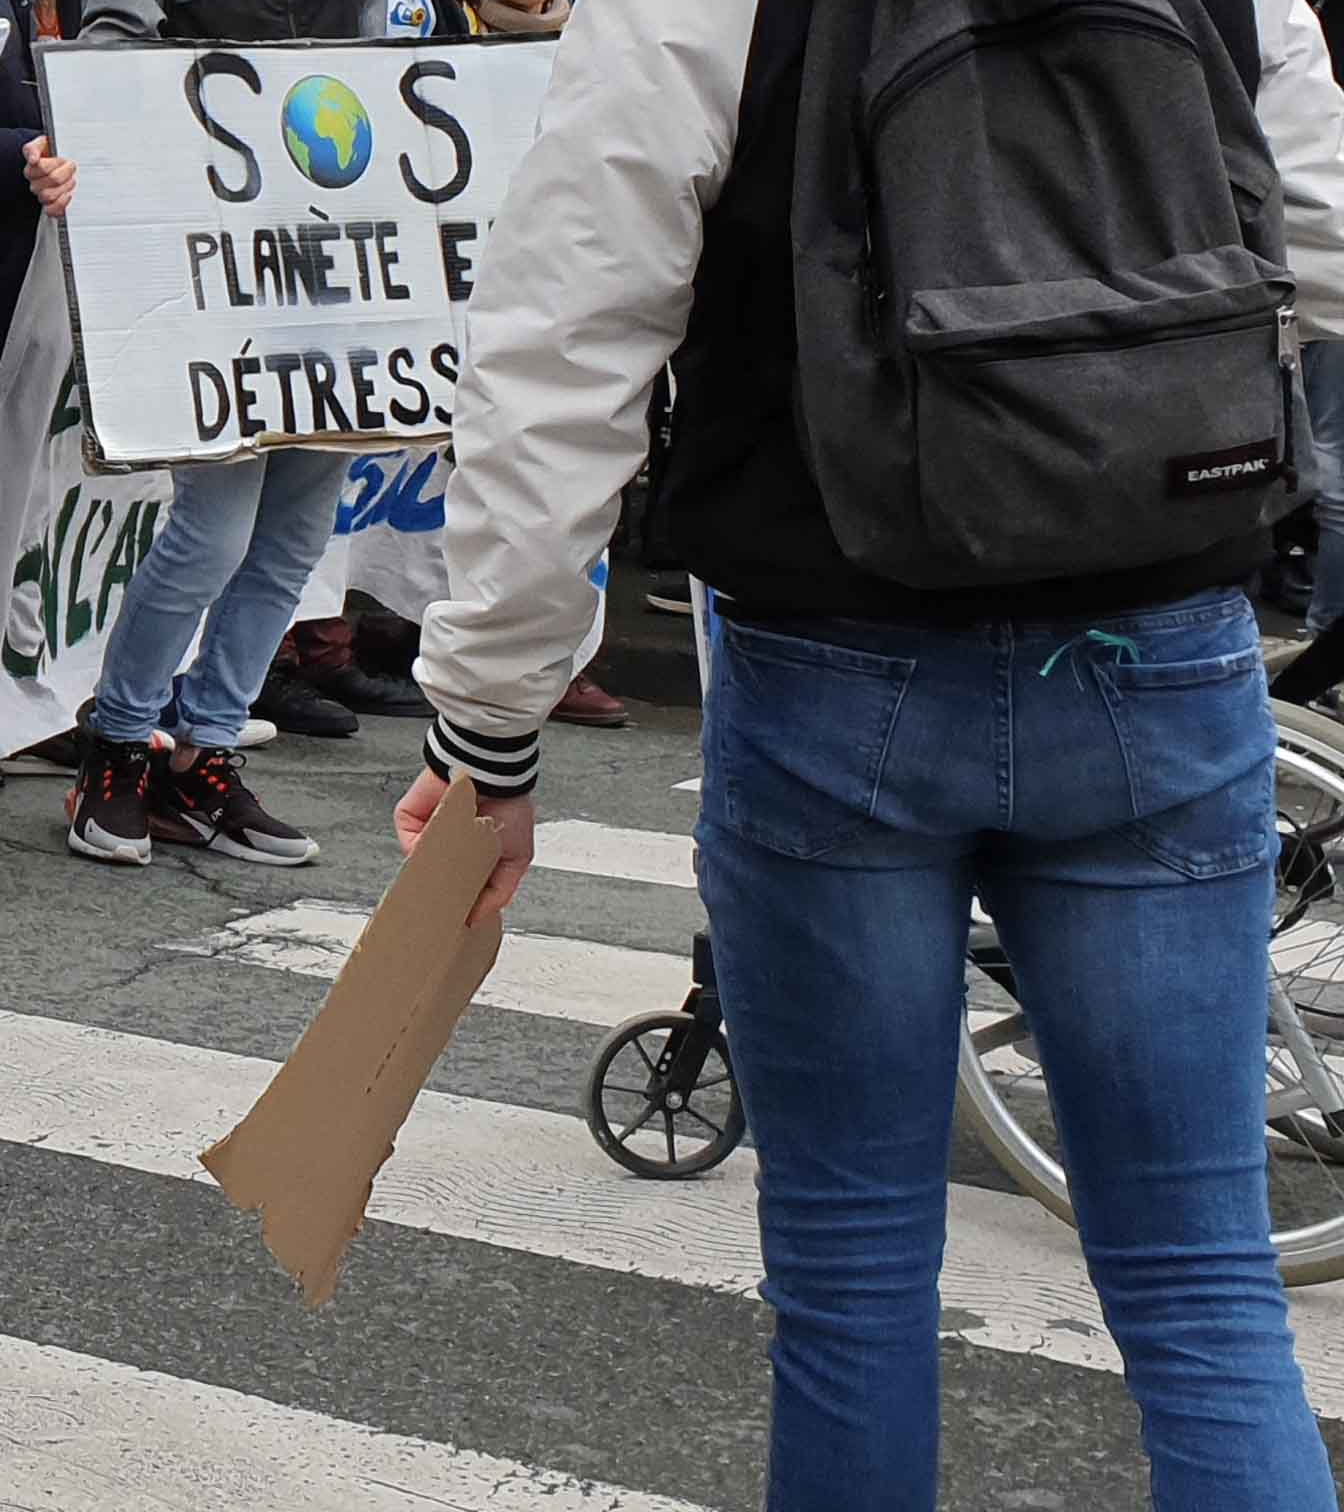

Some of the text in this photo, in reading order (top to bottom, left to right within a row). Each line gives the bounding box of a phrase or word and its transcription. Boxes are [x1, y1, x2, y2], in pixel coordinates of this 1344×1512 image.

[186, 205, 496, 312] PLANÈTE E
[188, 338, 462, 442] DÉTRESS
[1187, 458, 1268, 482] EASTPAK
